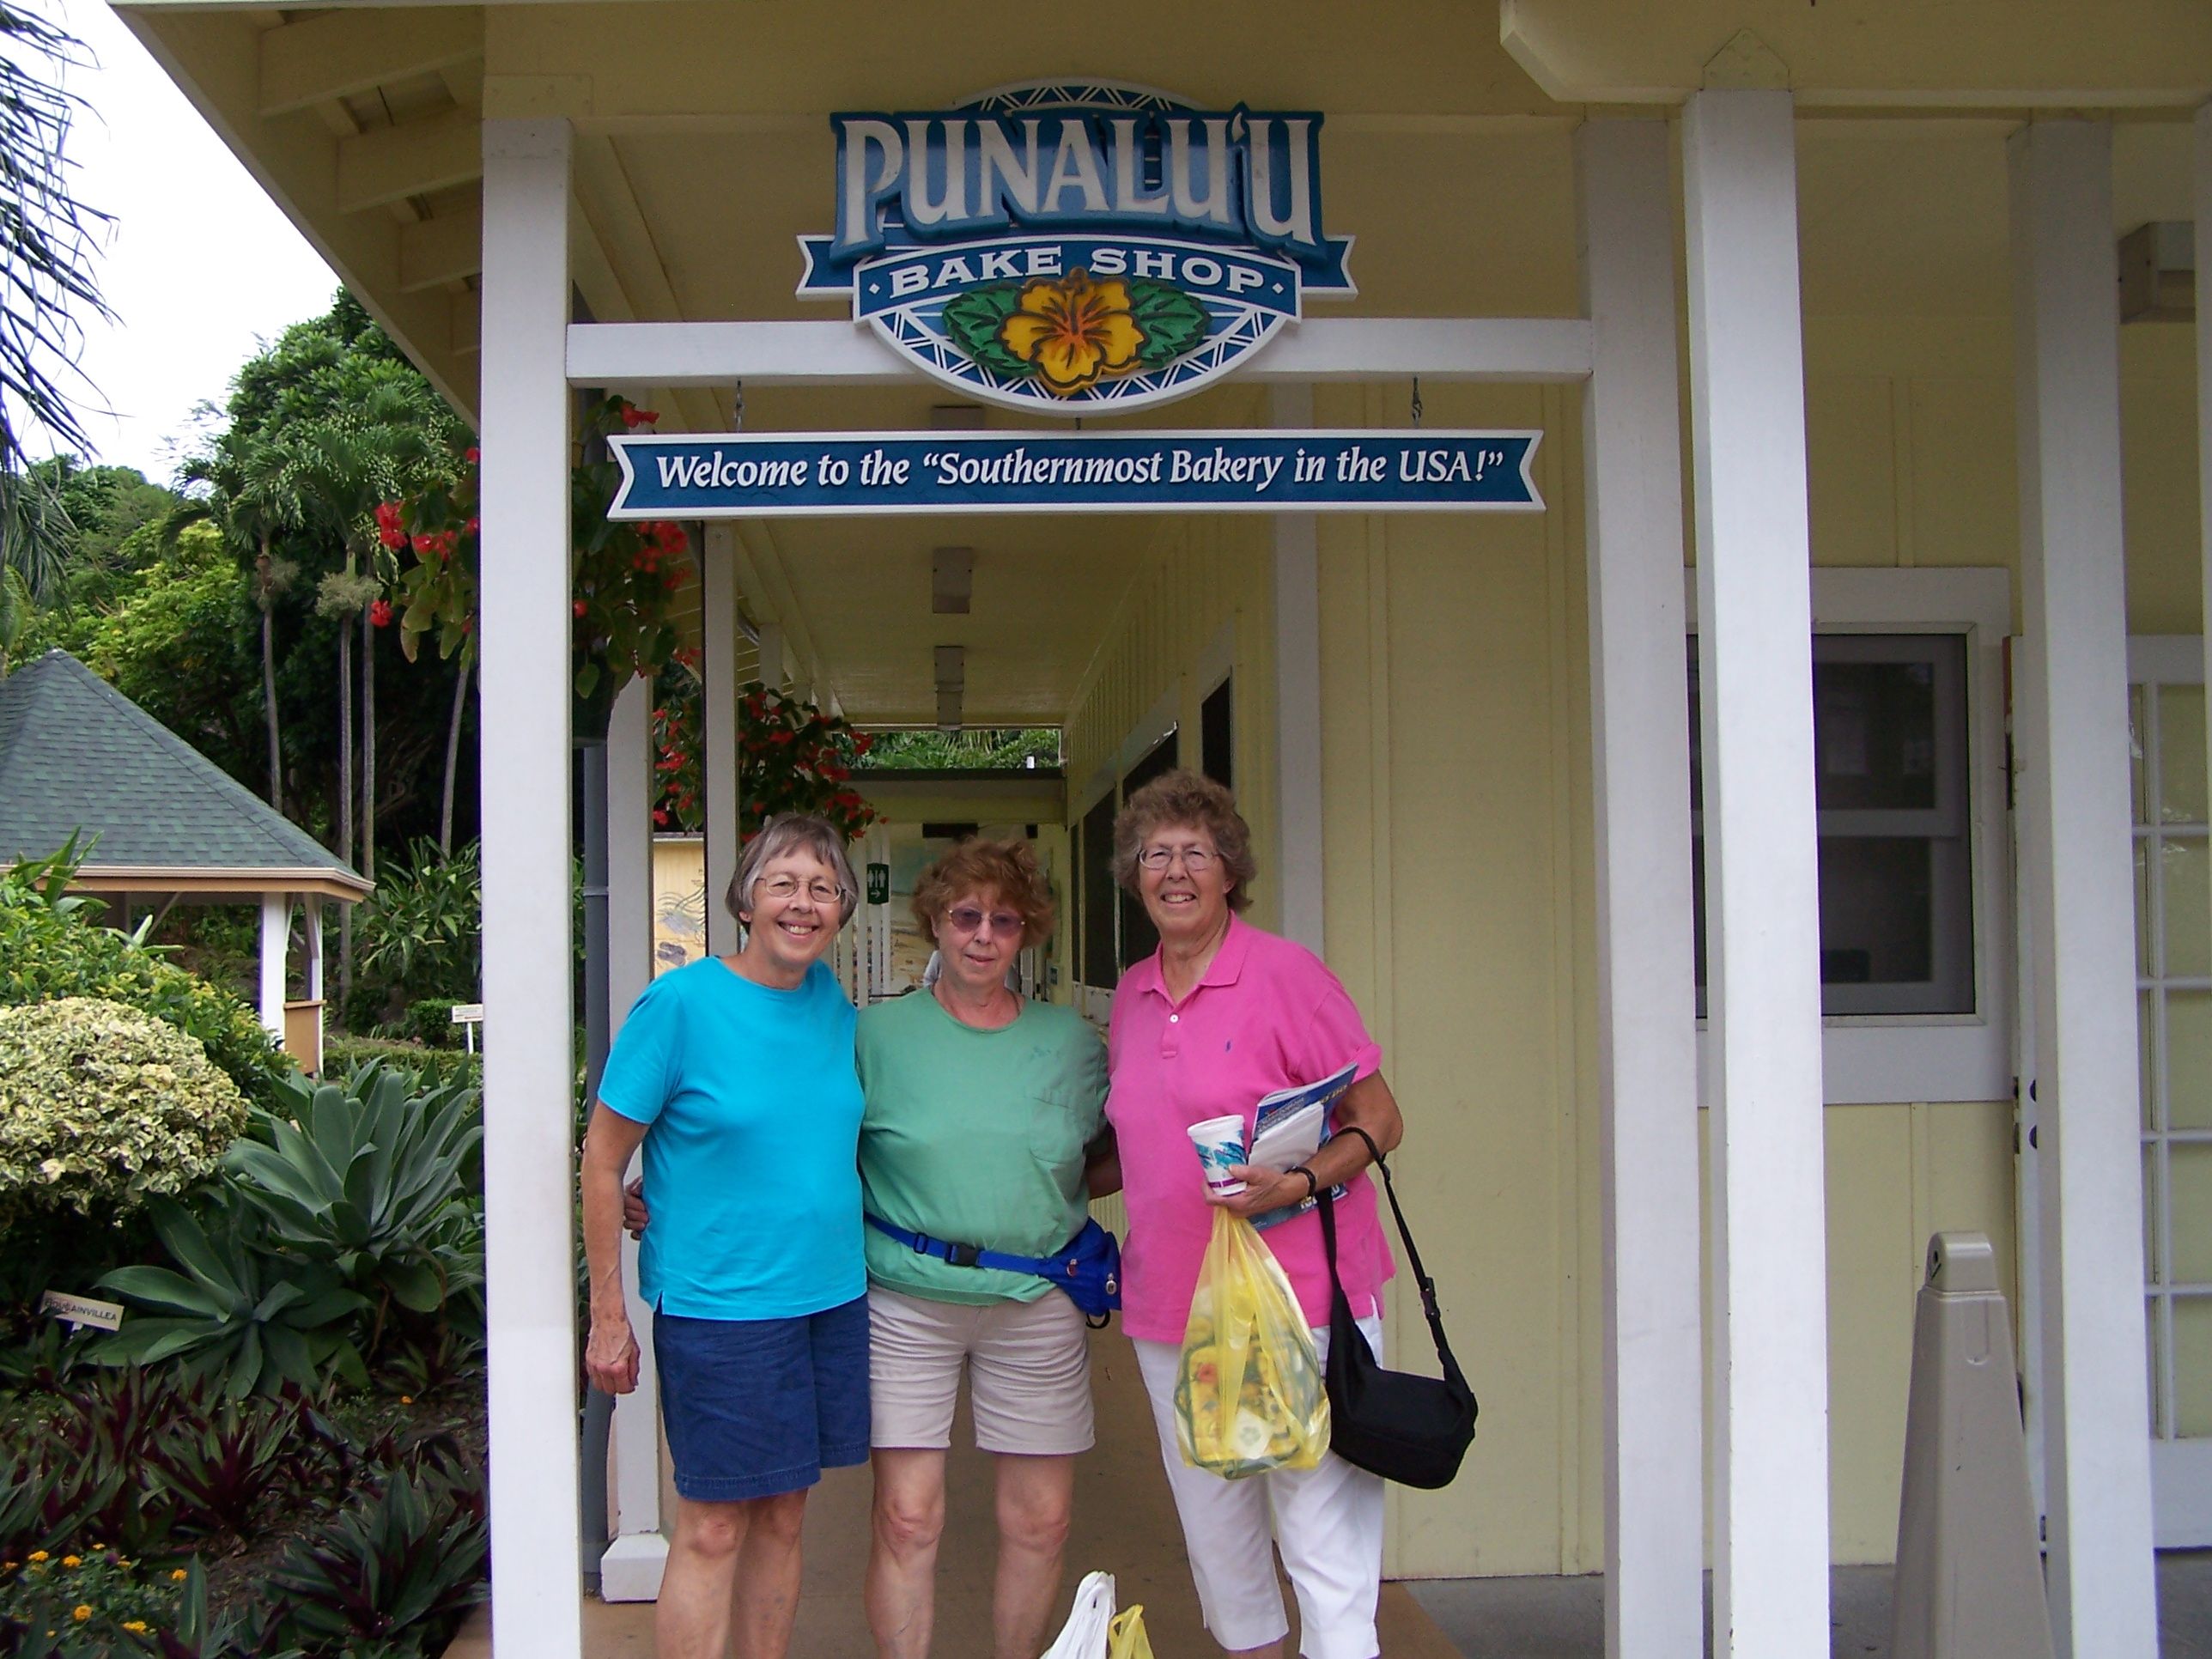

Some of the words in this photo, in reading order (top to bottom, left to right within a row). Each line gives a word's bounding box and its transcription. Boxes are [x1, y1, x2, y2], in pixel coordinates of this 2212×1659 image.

[890, 246, 1062, 299] BAKE
[1091, 247, 1265, 294] SHOP
[656, 451, 808, 488] Welcome
[817, 454, 849, 486] to
[860, 449, 909, 486] the
[923, 447, 1164, 484] “Southernmost
[1170, 447, 1284, 492] Bakery
[1294, 447, 1326, 483] in
[1336, 446, 1387, 483] the
[1400, 450, 1504, 483] USA!”
